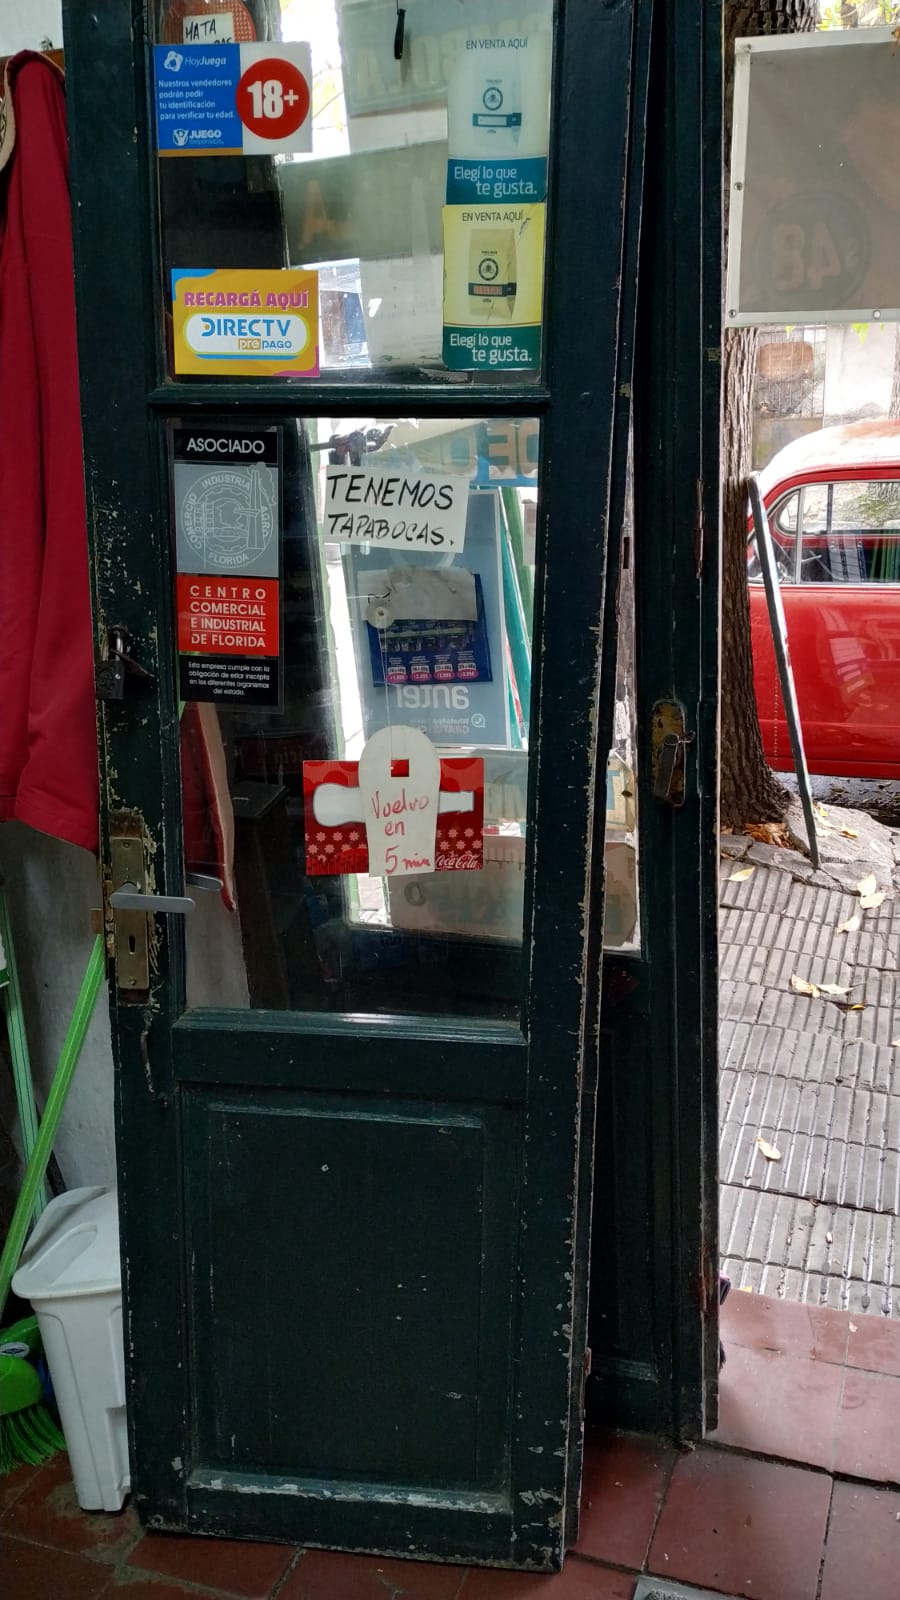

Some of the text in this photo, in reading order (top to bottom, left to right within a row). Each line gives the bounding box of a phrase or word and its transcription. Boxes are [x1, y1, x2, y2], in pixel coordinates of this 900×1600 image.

[466, 36, 529, 50] EN VENTA AQUÍ
[184, 56, 227, 68] HoyJuega
[191, 79, 232, 87] vendedores
[159, 90, 204, 99] podrán pedir
[247, 79, 299, 119] 18+
[168, 100, 216, 109] identificación
[189, 129, 222, 139] JUEGO
[454, 166, 517, 182] Elegí lo que
[476, 181, 537, 198] te gusta.
[462, 209, 524, 223] EN VENTA AQUÍ
[184, 290, 309, 311] RECARGÁ AQUÍ
[201, 317, 291, 337] DIRECTV
[450, 333, 512, 349] Elegí lo que
[472, 347, 533, 365] te gusta.
[186, 437, 265, 454] ASOCIADO
[201, 474, 251, 492] INDUSTRIA
[327, 473, 454, 510] TENEMOS
[184, 492, 204, 550] COMERCIO
[260, 505, 271, 537] AGRO
[327, 513, 455, 546] TAPABOCAS.
[208, 551, 250, 566] FLORIDA
[190, 585, 266, 599] CENTRO
[190, 601, 266, 616] COMERCIAL
[190, 617, 267, 632] E INDUSTRIAL
[191, 633, 266, 648] DE FLORIDA
[188, 670, 219, 679] obligación
[201, 663, 227, 671] empresa
[227, 664, 250, 672] cumple
[207, 679, 236, 688] diferentes
[213, 687, 223, 695] del
[372, 787, 430, 819] Vuelvo
[384, 821, 405, 836] en
[384, 844, 431, 875] 5 min
